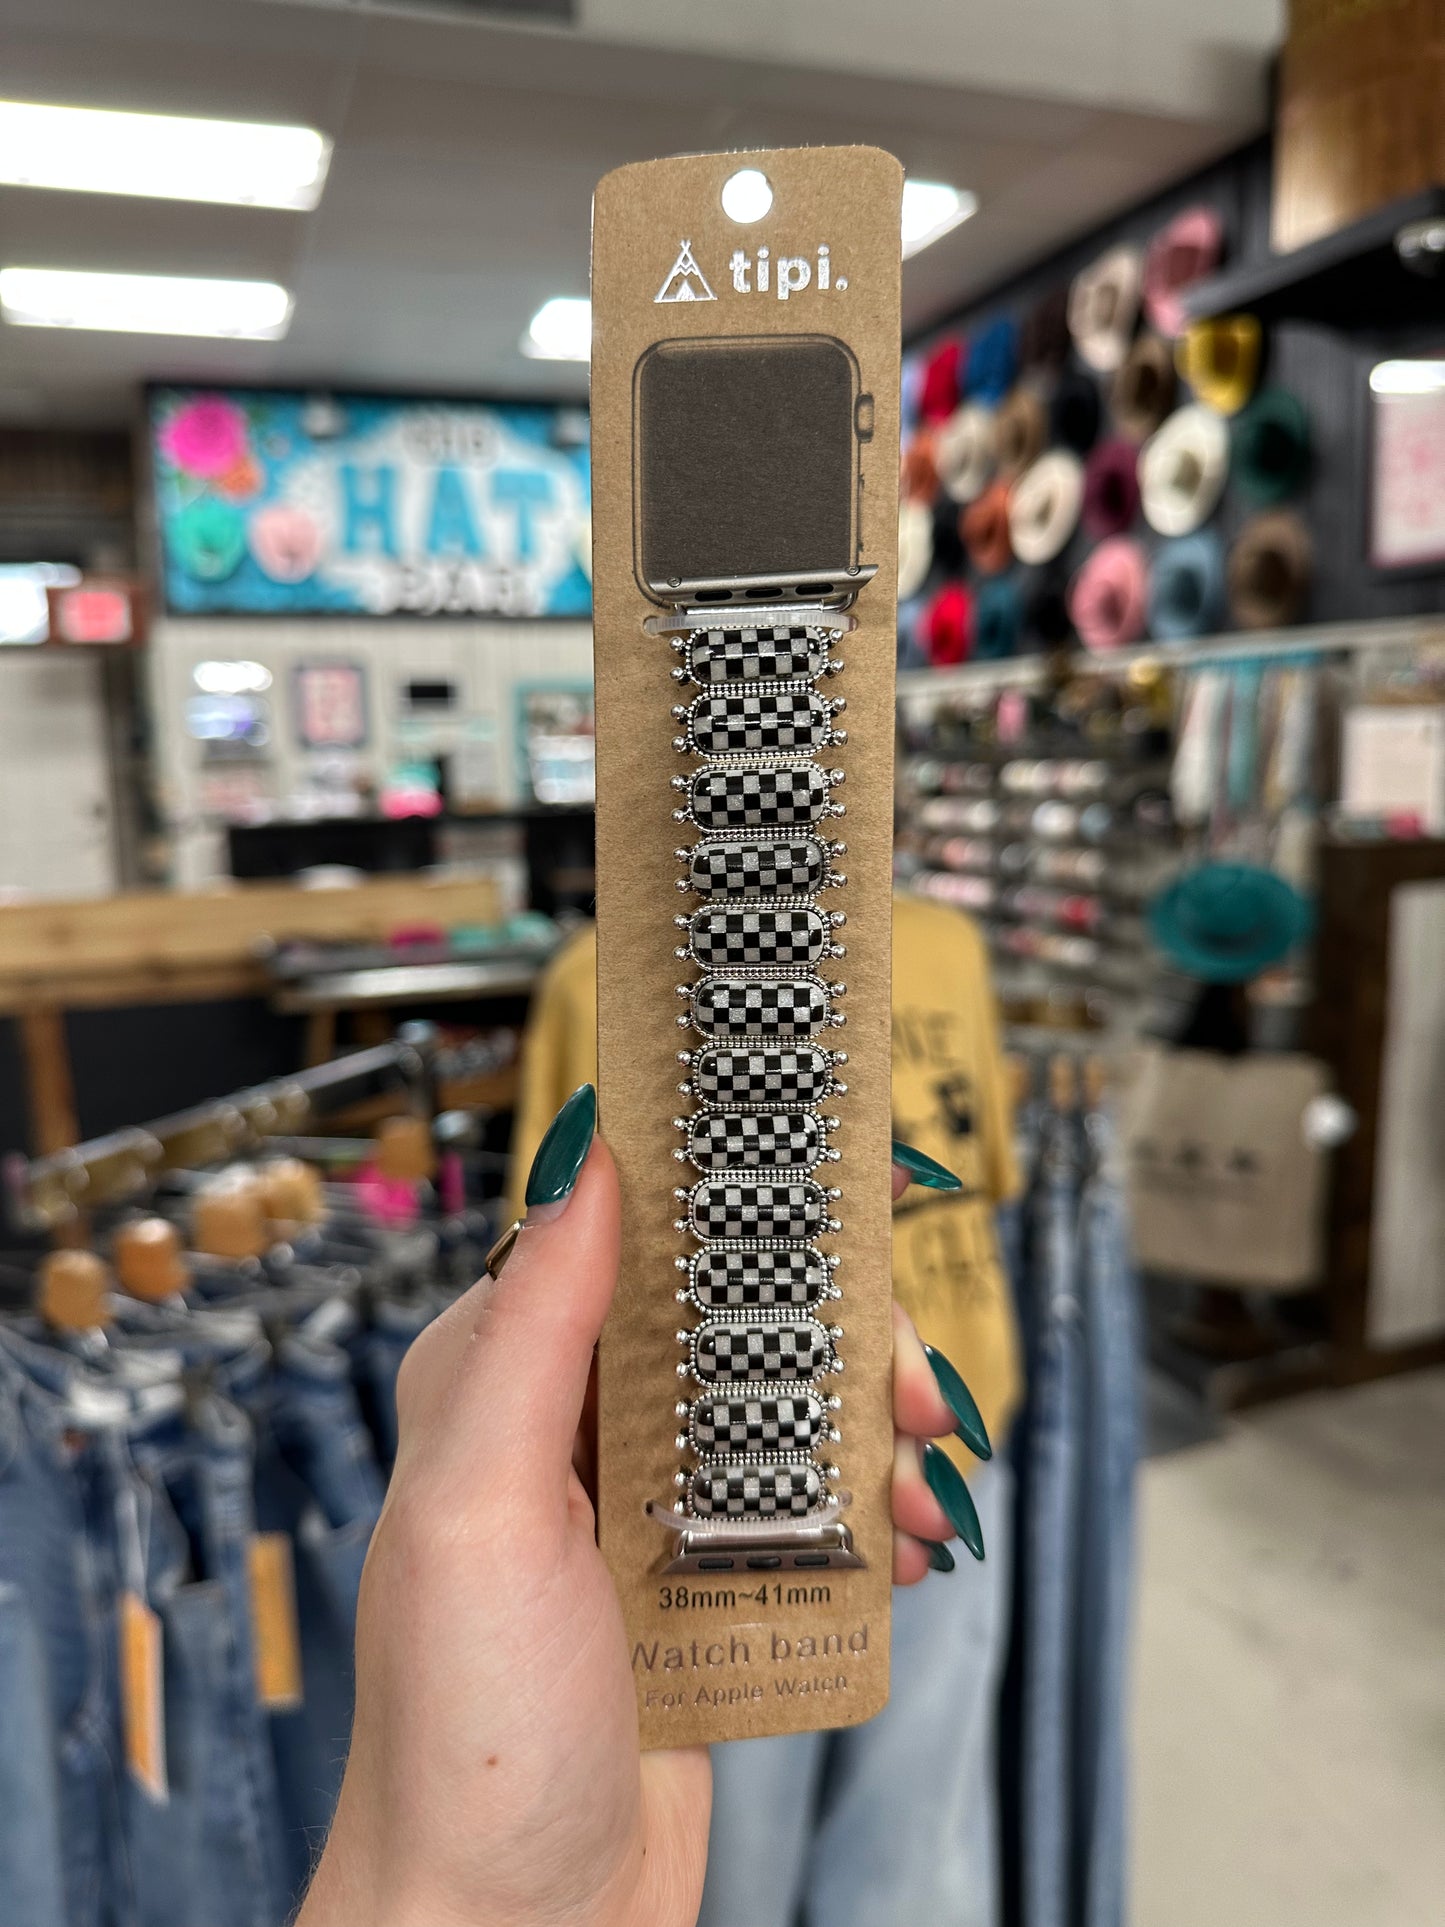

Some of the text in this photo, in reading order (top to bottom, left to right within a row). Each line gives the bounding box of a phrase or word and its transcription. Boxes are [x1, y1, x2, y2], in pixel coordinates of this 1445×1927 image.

[729, 244, 848, 300] tipi.
[338, 460, 554, 560] HAT
[659, 1583, 832, 1610] 38mm~41mm
[771, 1624, 869, 1662] band
[645, 1674, 848, 1709] For Apple Watch
